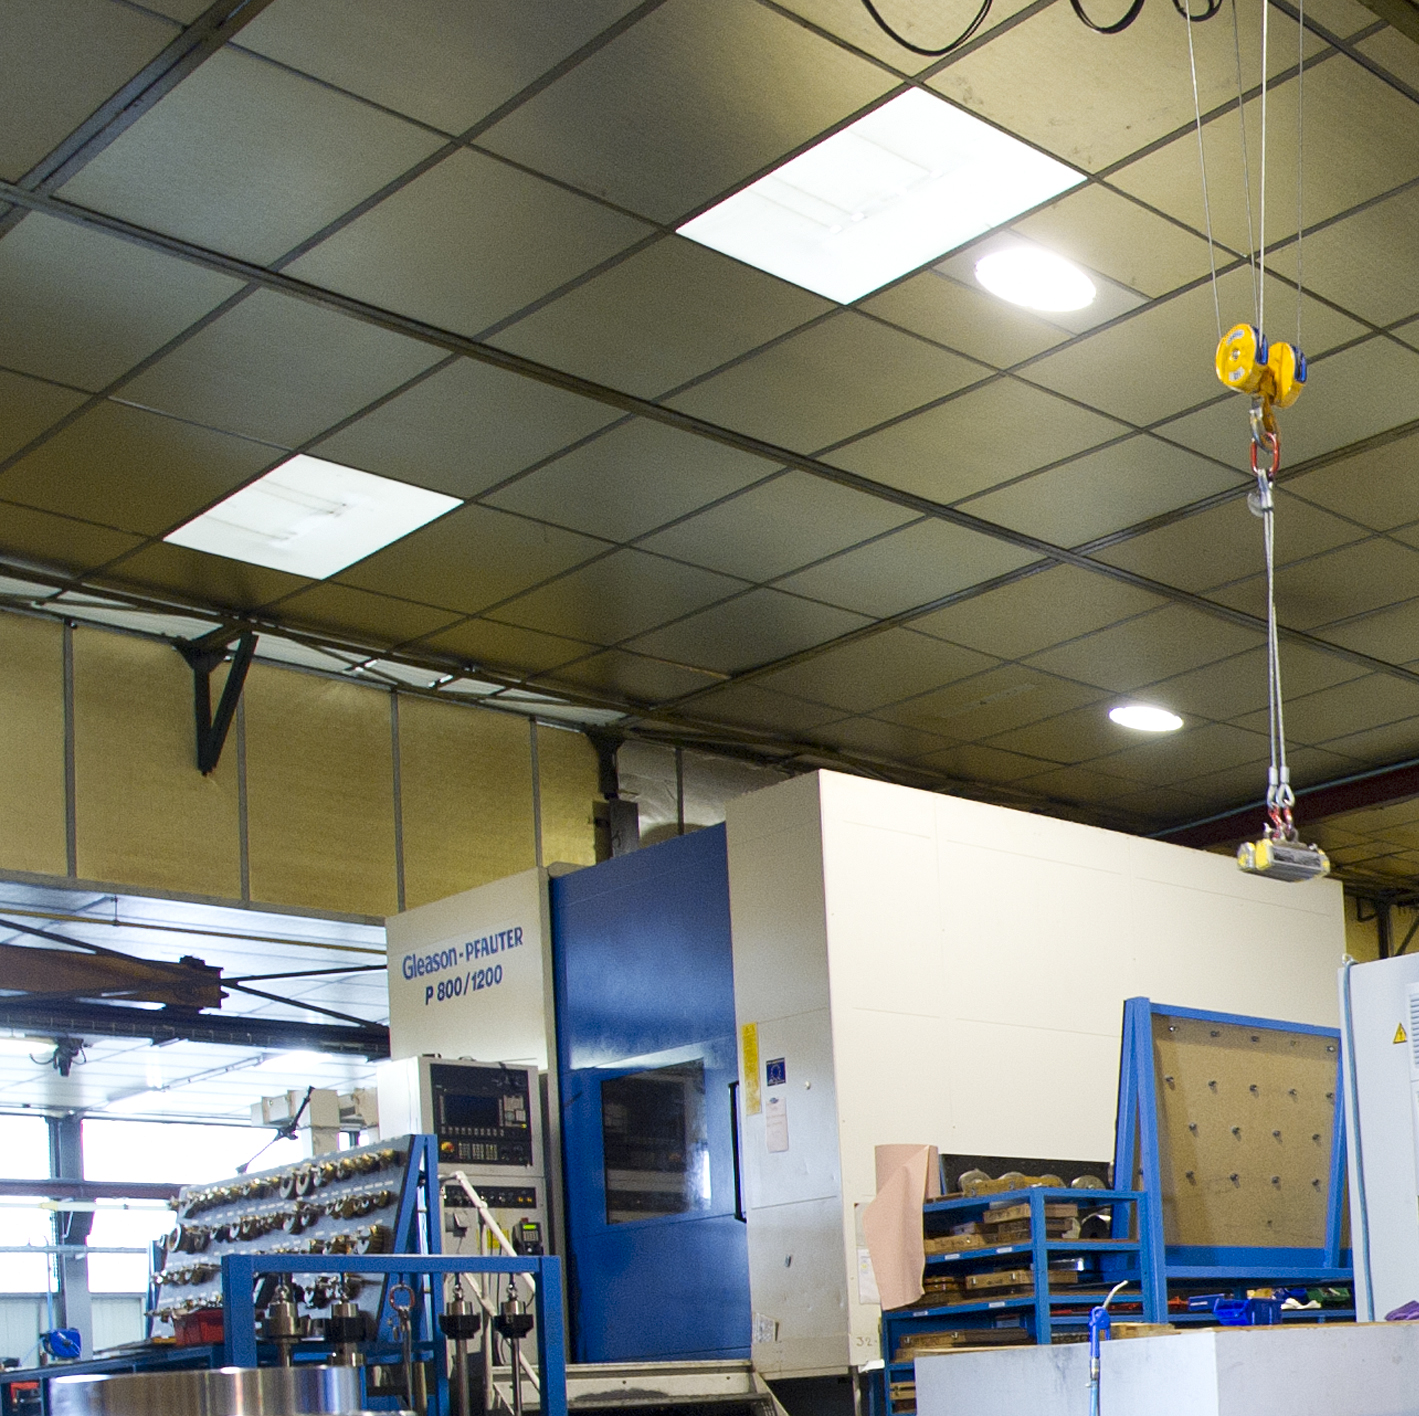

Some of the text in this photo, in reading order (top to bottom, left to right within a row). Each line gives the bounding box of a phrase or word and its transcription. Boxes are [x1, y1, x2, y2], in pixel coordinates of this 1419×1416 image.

[402, 948, 457, 980] Gleason
[465, 926, 523, 962] PFAUTER
[425, 985, 434, 1005] P
